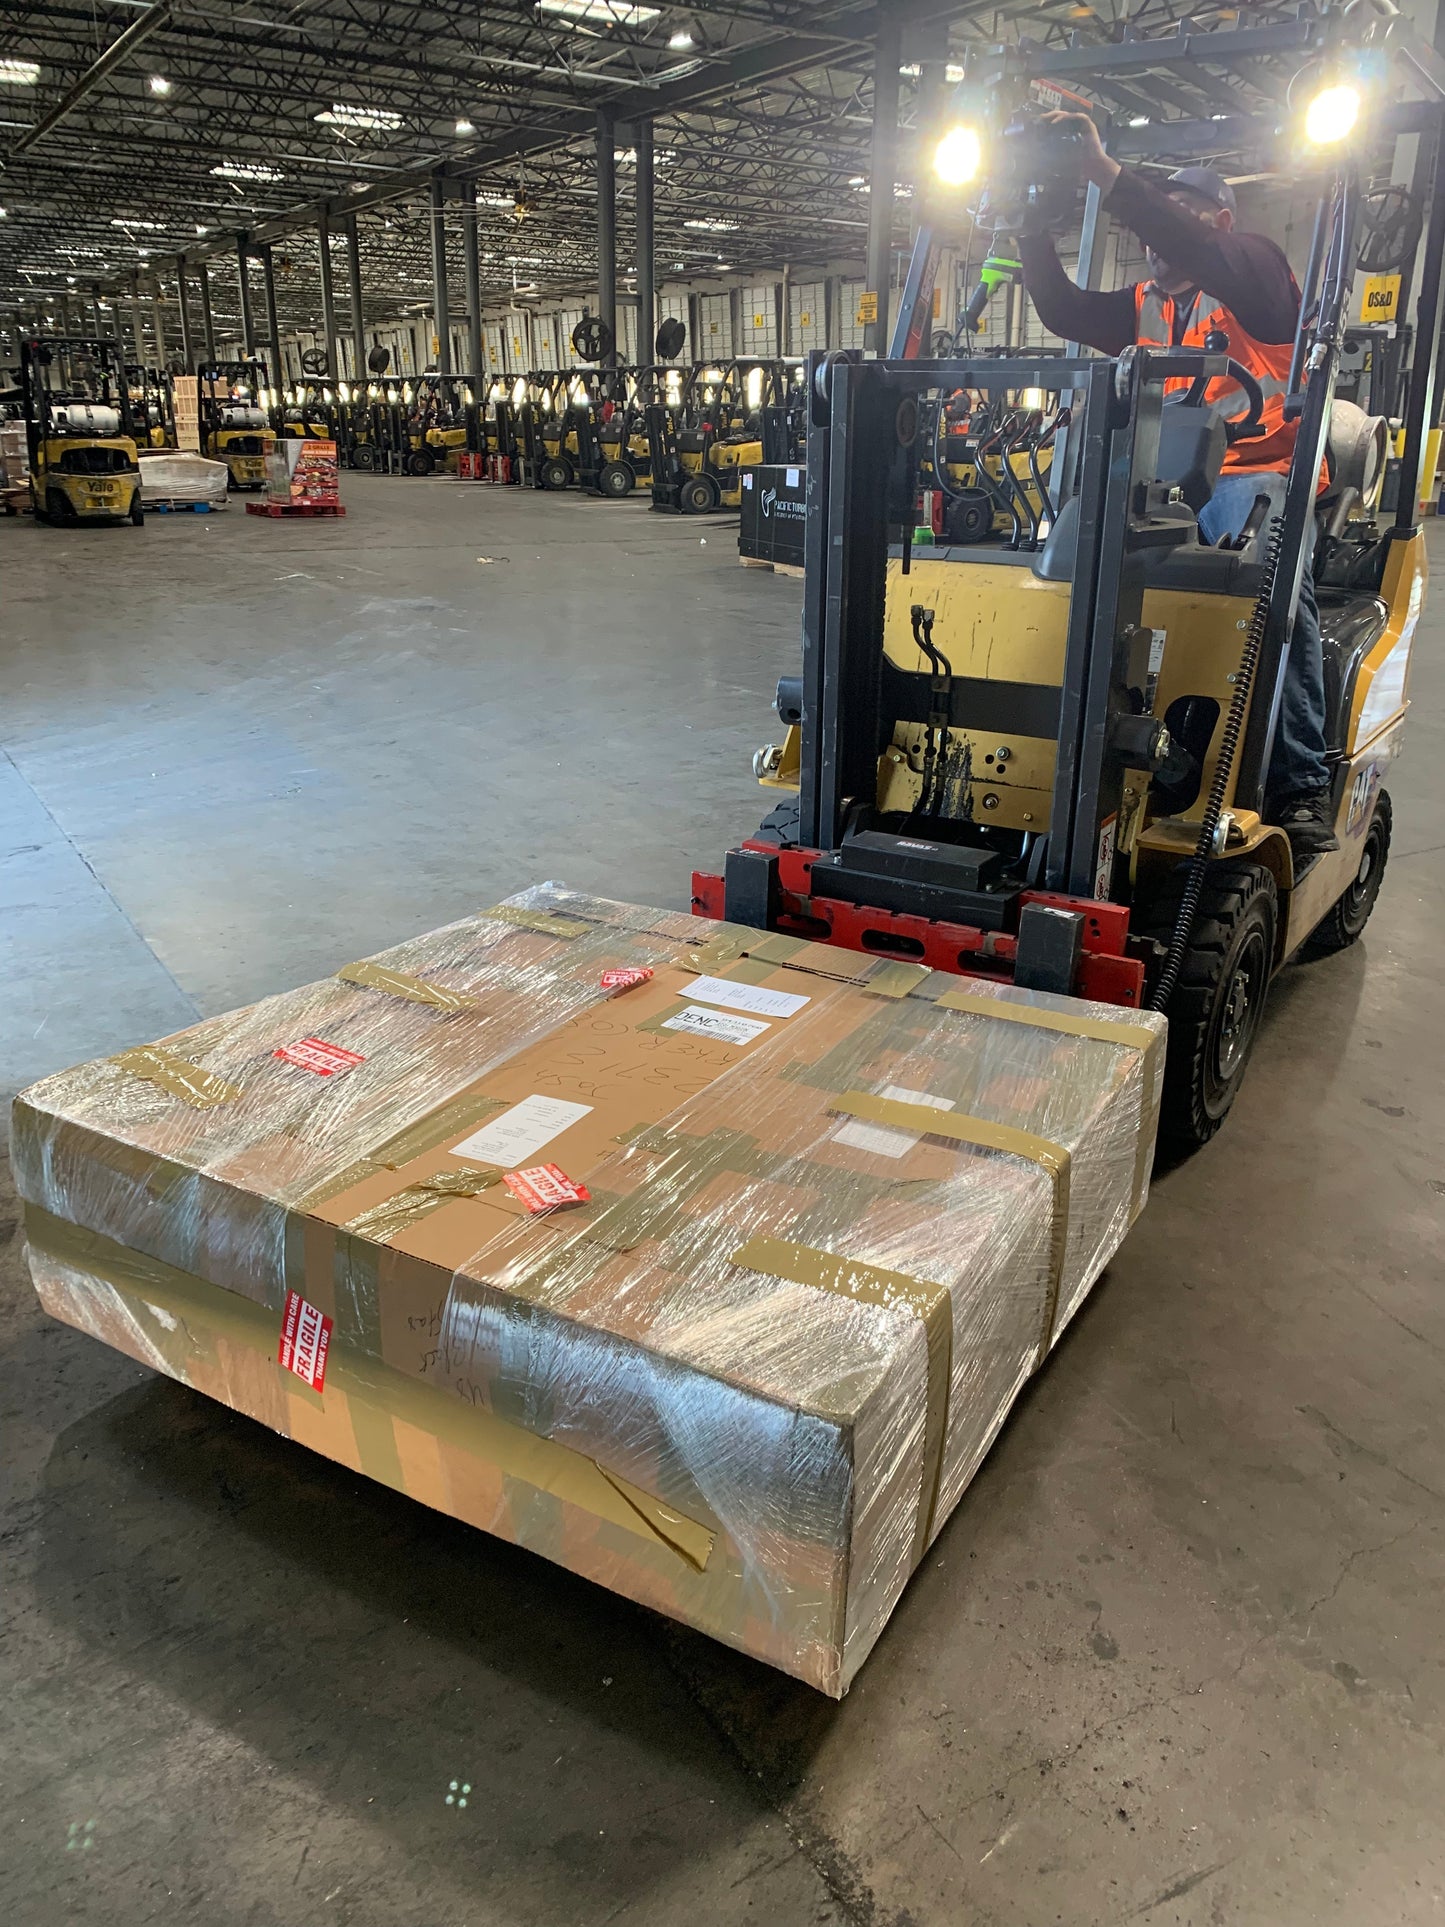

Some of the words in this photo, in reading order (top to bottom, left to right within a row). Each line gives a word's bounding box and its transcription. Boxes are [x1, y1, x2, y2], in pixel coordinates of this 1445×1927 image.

[1367, 290, 1393, 308] OS&D
[87, 480, 114, 493] Yale
[774, 500, 792, 511] PACIFIC
[291, 1044, 348, 1070] FRAGILE
[289, 1292, 300, 1316] CARE
[285, 1316, 295, 1337] WITH
[296, 1304, 319, 1381] FRAGILE
[320, 1329, 329, 1350] YOU
[315, 1348, 326, 1380] THANK
